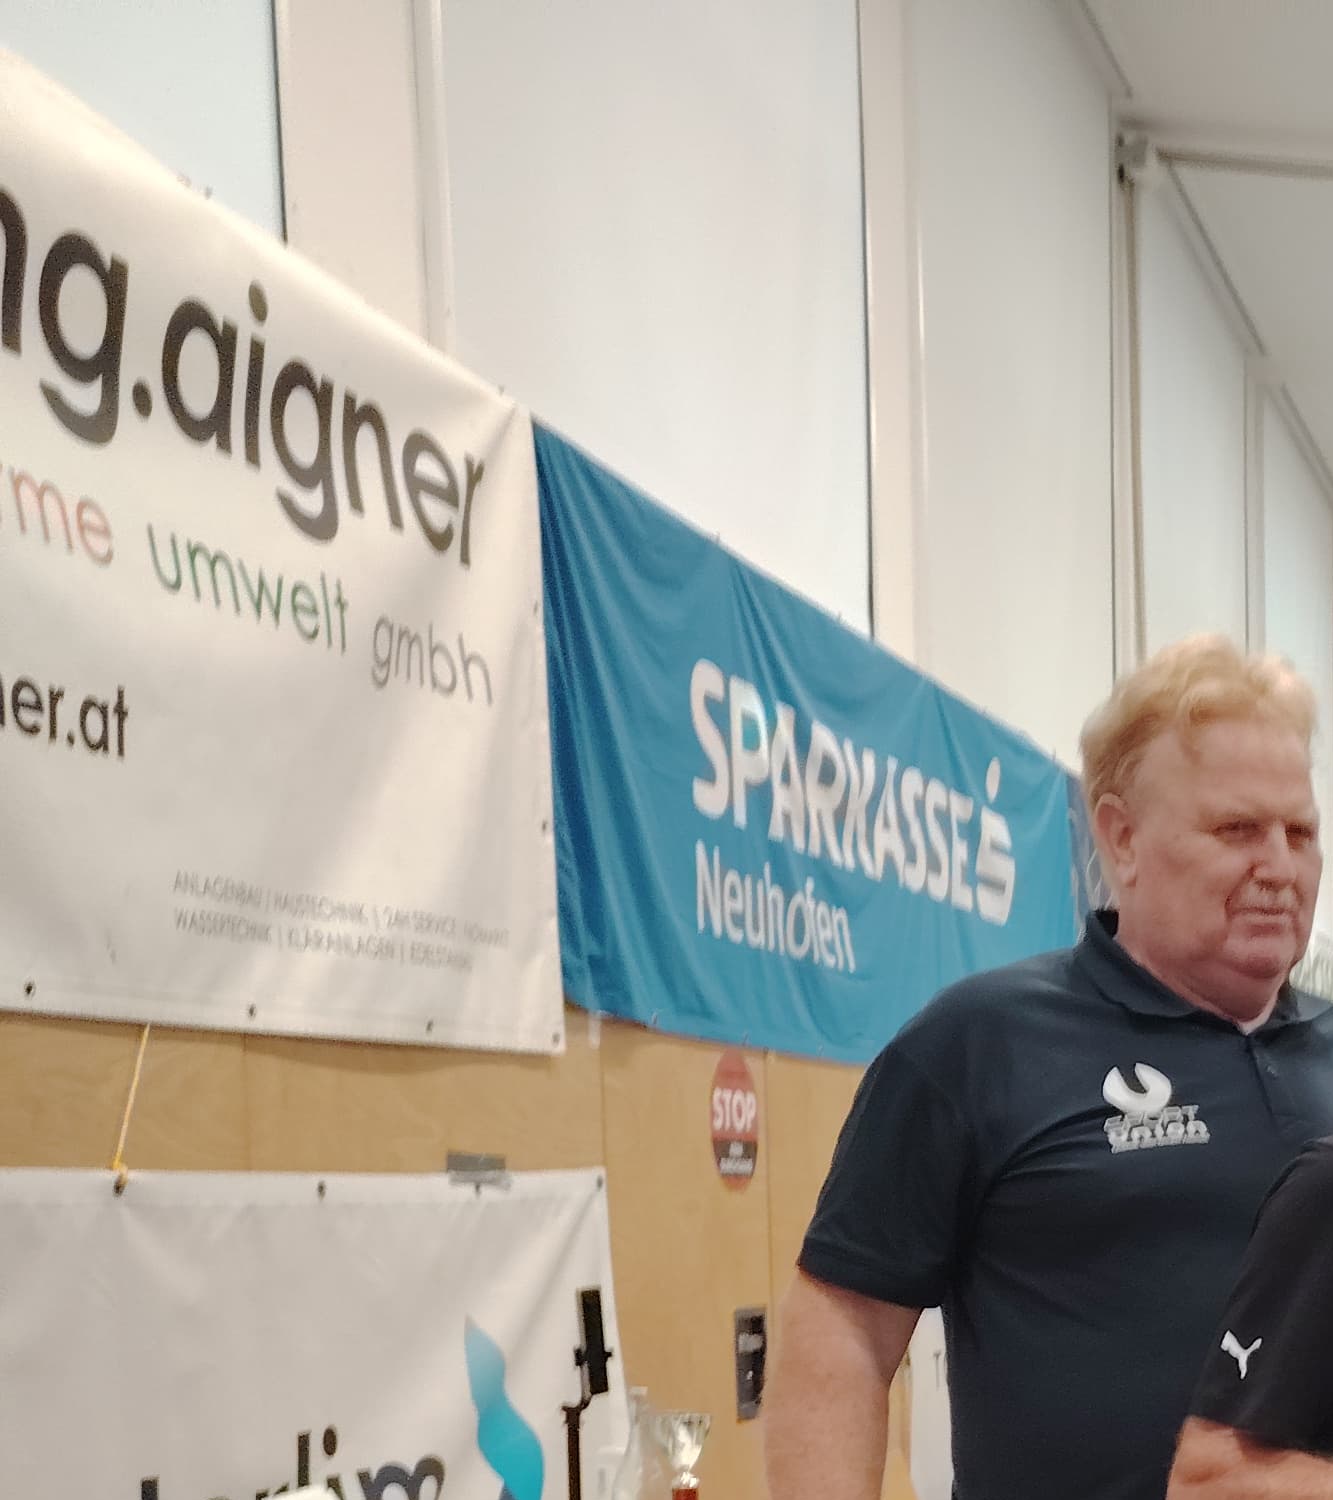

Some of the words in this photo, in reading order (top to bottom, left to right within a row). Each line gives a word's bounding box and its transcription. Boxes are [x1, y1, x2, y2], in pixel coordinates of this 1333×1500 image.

[0, 186, 485, 568] g.aigner
[0, 466, 113, 568] me
[146, 520, 349, 653] umwelt
[372, 610, 494, 707] gmbh
[0, 672, 129, 758] er.at
[689, 657, 975, 912] SPARKASSE
[695, 839, 856, 974] Neuhofen
[712, 1086, 758, 1133] STOP
